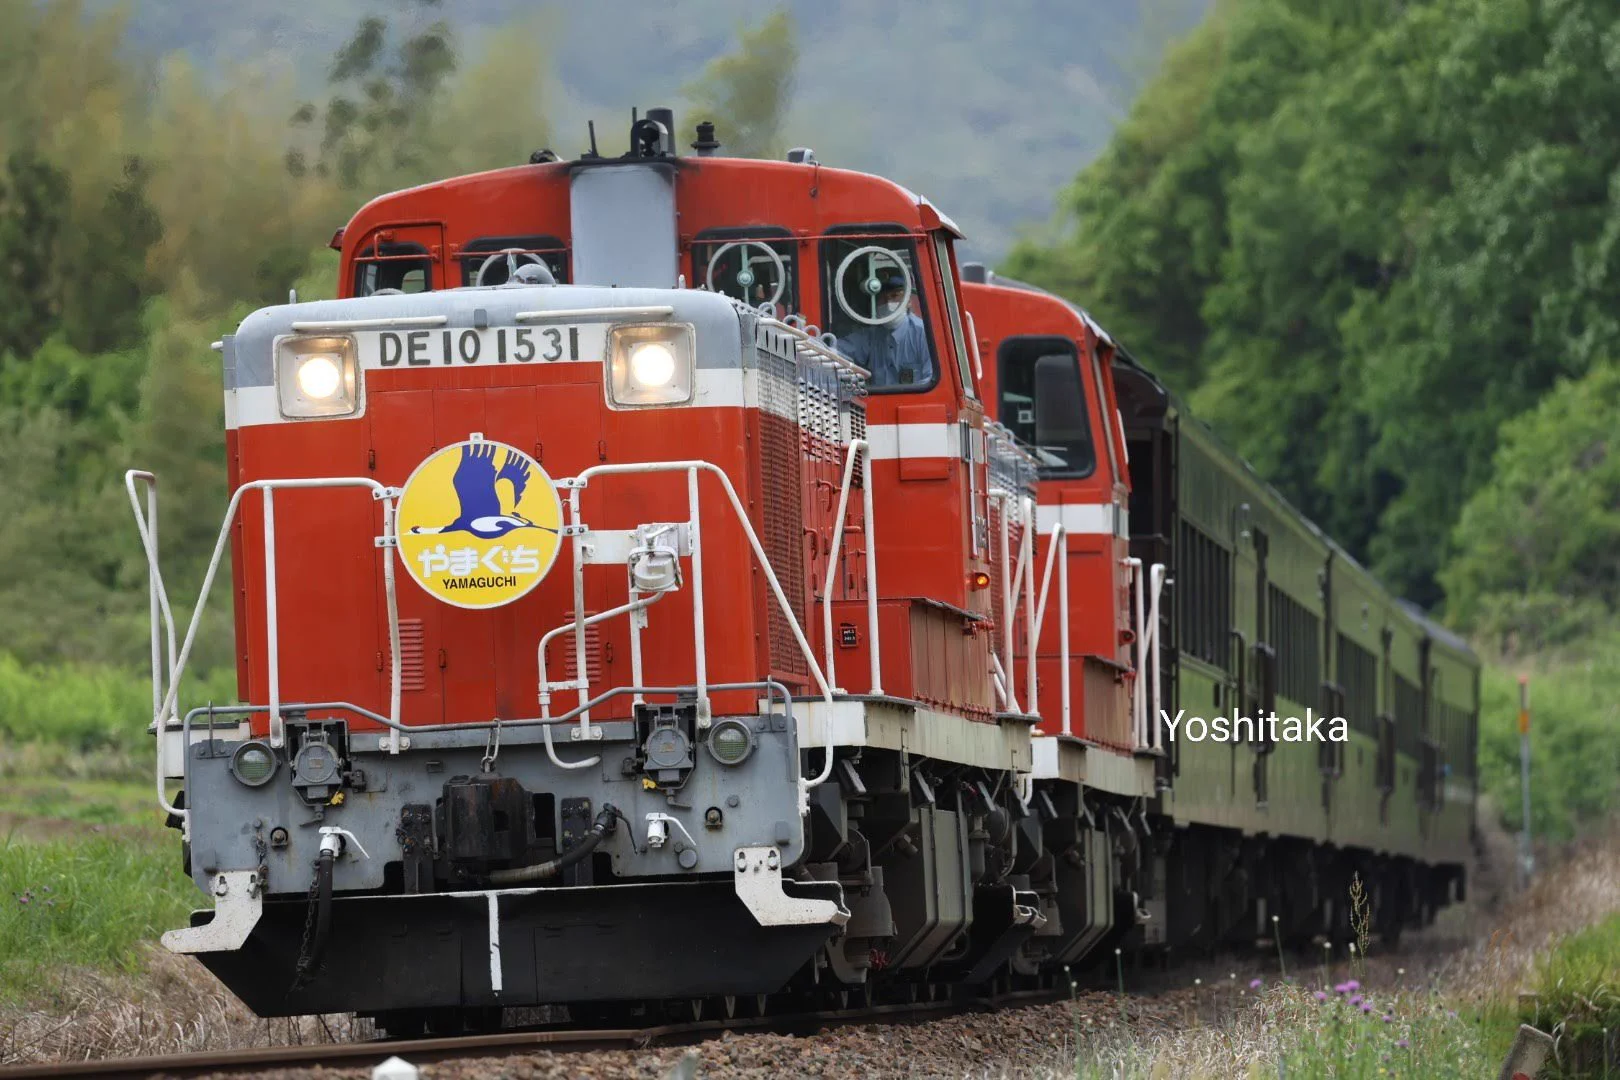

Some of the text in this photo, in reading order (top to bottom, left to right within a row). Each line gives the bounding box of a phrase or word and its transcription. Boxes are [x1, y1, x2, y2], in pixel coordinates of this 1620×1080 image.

[497, 327, 579, 363] 1531
[418, 543, 539, 578] やまぐち
[442, 575, 517, 590] YAMAGUCHI
